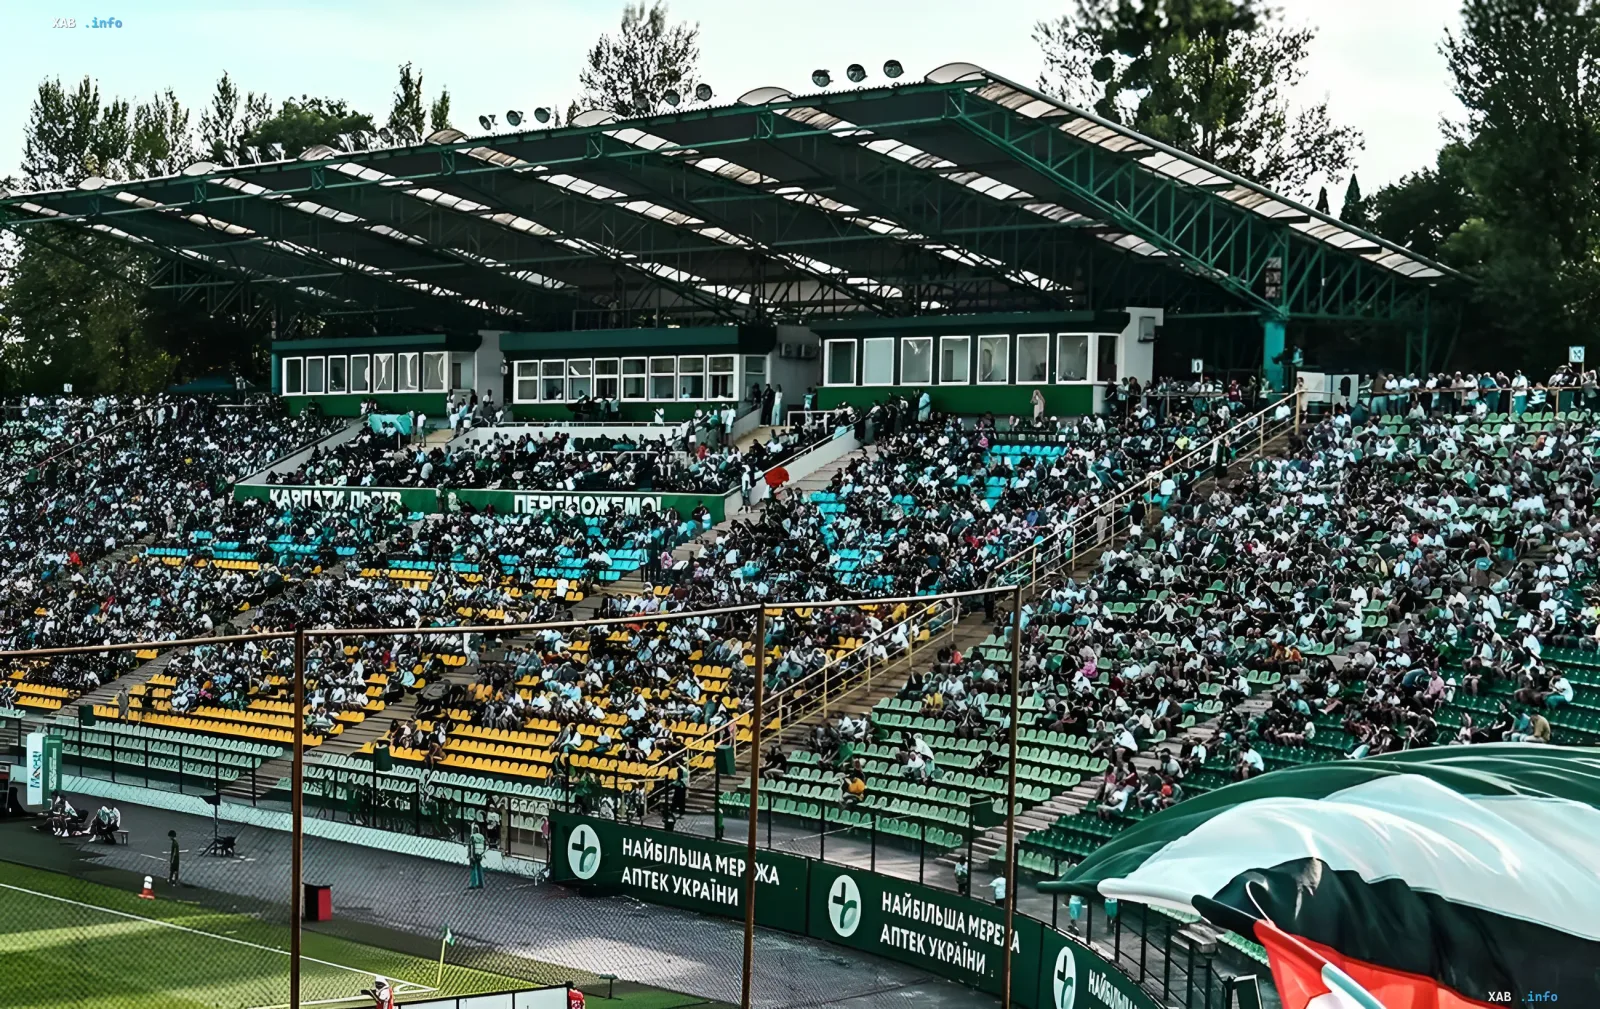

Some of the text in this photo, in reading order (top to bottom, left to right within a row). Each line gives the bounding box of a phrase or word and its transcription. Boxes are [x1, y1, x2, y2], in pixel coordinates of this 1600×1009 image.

[622, 837, 780, 886] НАЙБІЛЬША МЕРЖА
[621, 866, 739, 907] АПТЕК УКРАЇНИ
[882, 891, 965, 934] НАЙБІЛЬША
[880, 923, 986, 975] АПТЕК УКРАЇНИ
